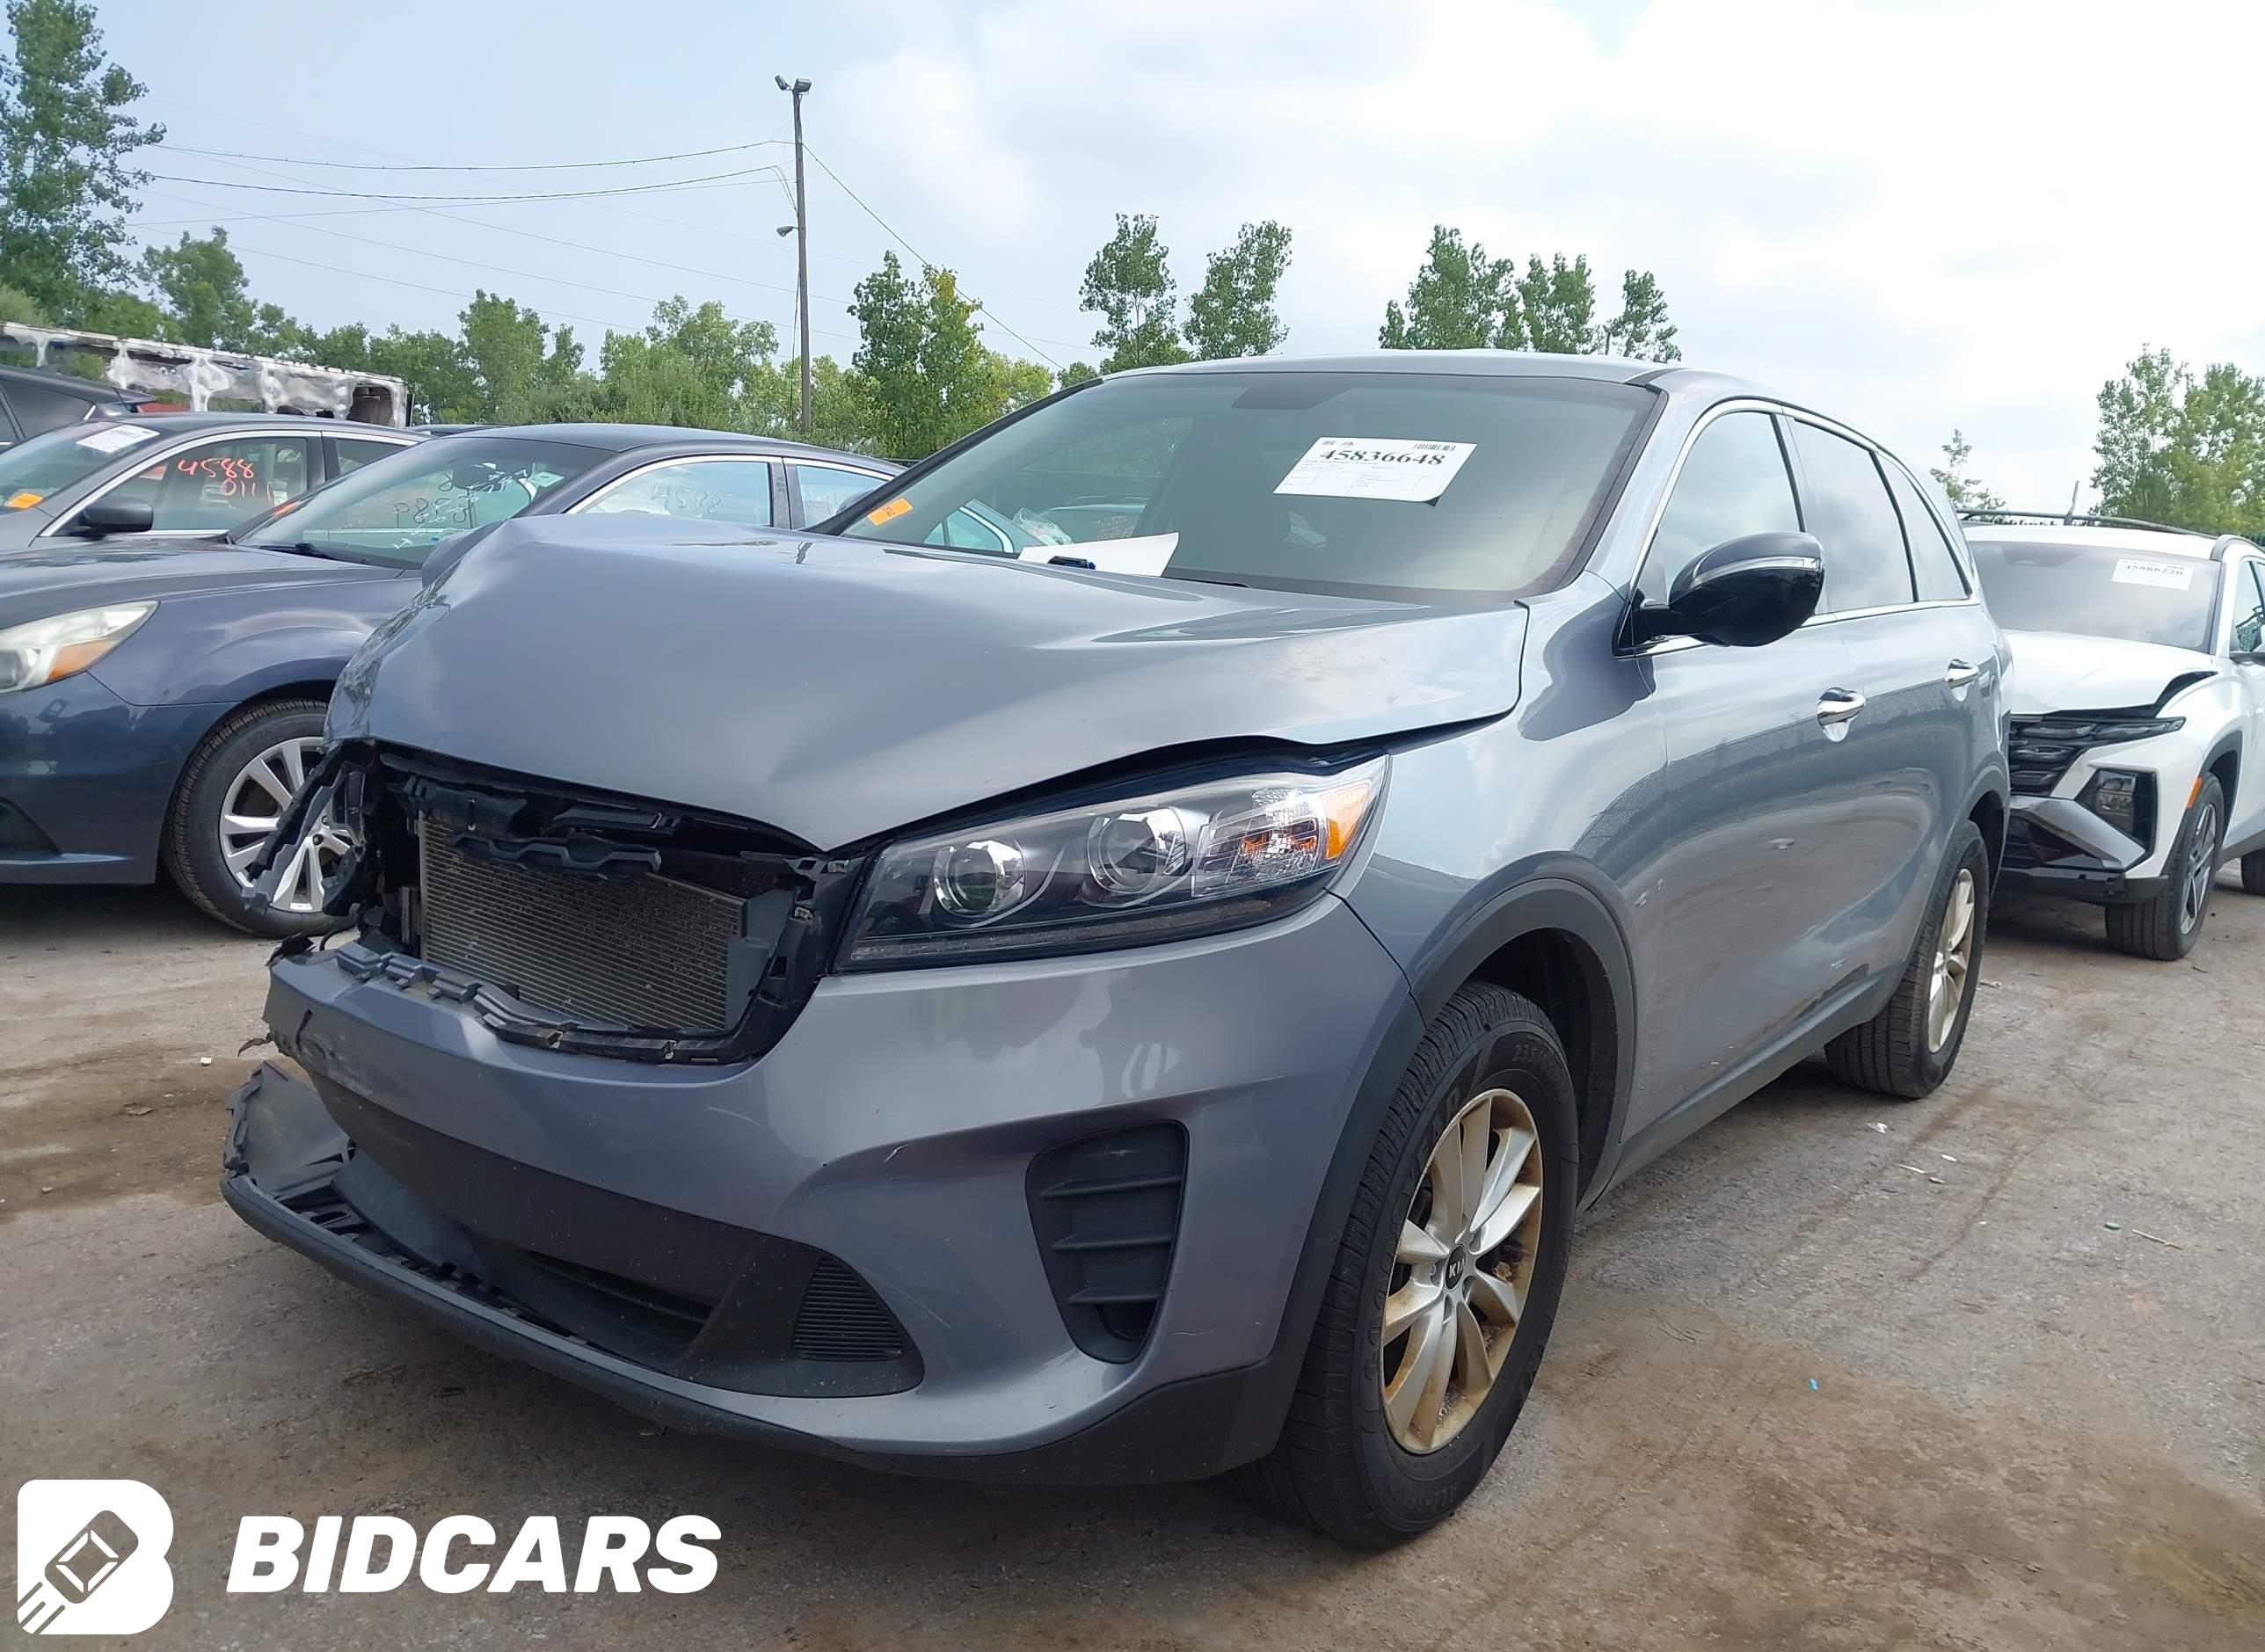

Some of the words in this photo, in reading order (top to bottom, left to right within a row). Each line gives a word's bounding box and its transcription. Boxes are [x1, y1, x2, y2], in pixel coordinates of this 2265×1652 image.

[1320, 449, 1446, 466] 45836648
[178, 458, 254, 478] 4588
[1449, 1257, 1465, 1278] KIA
